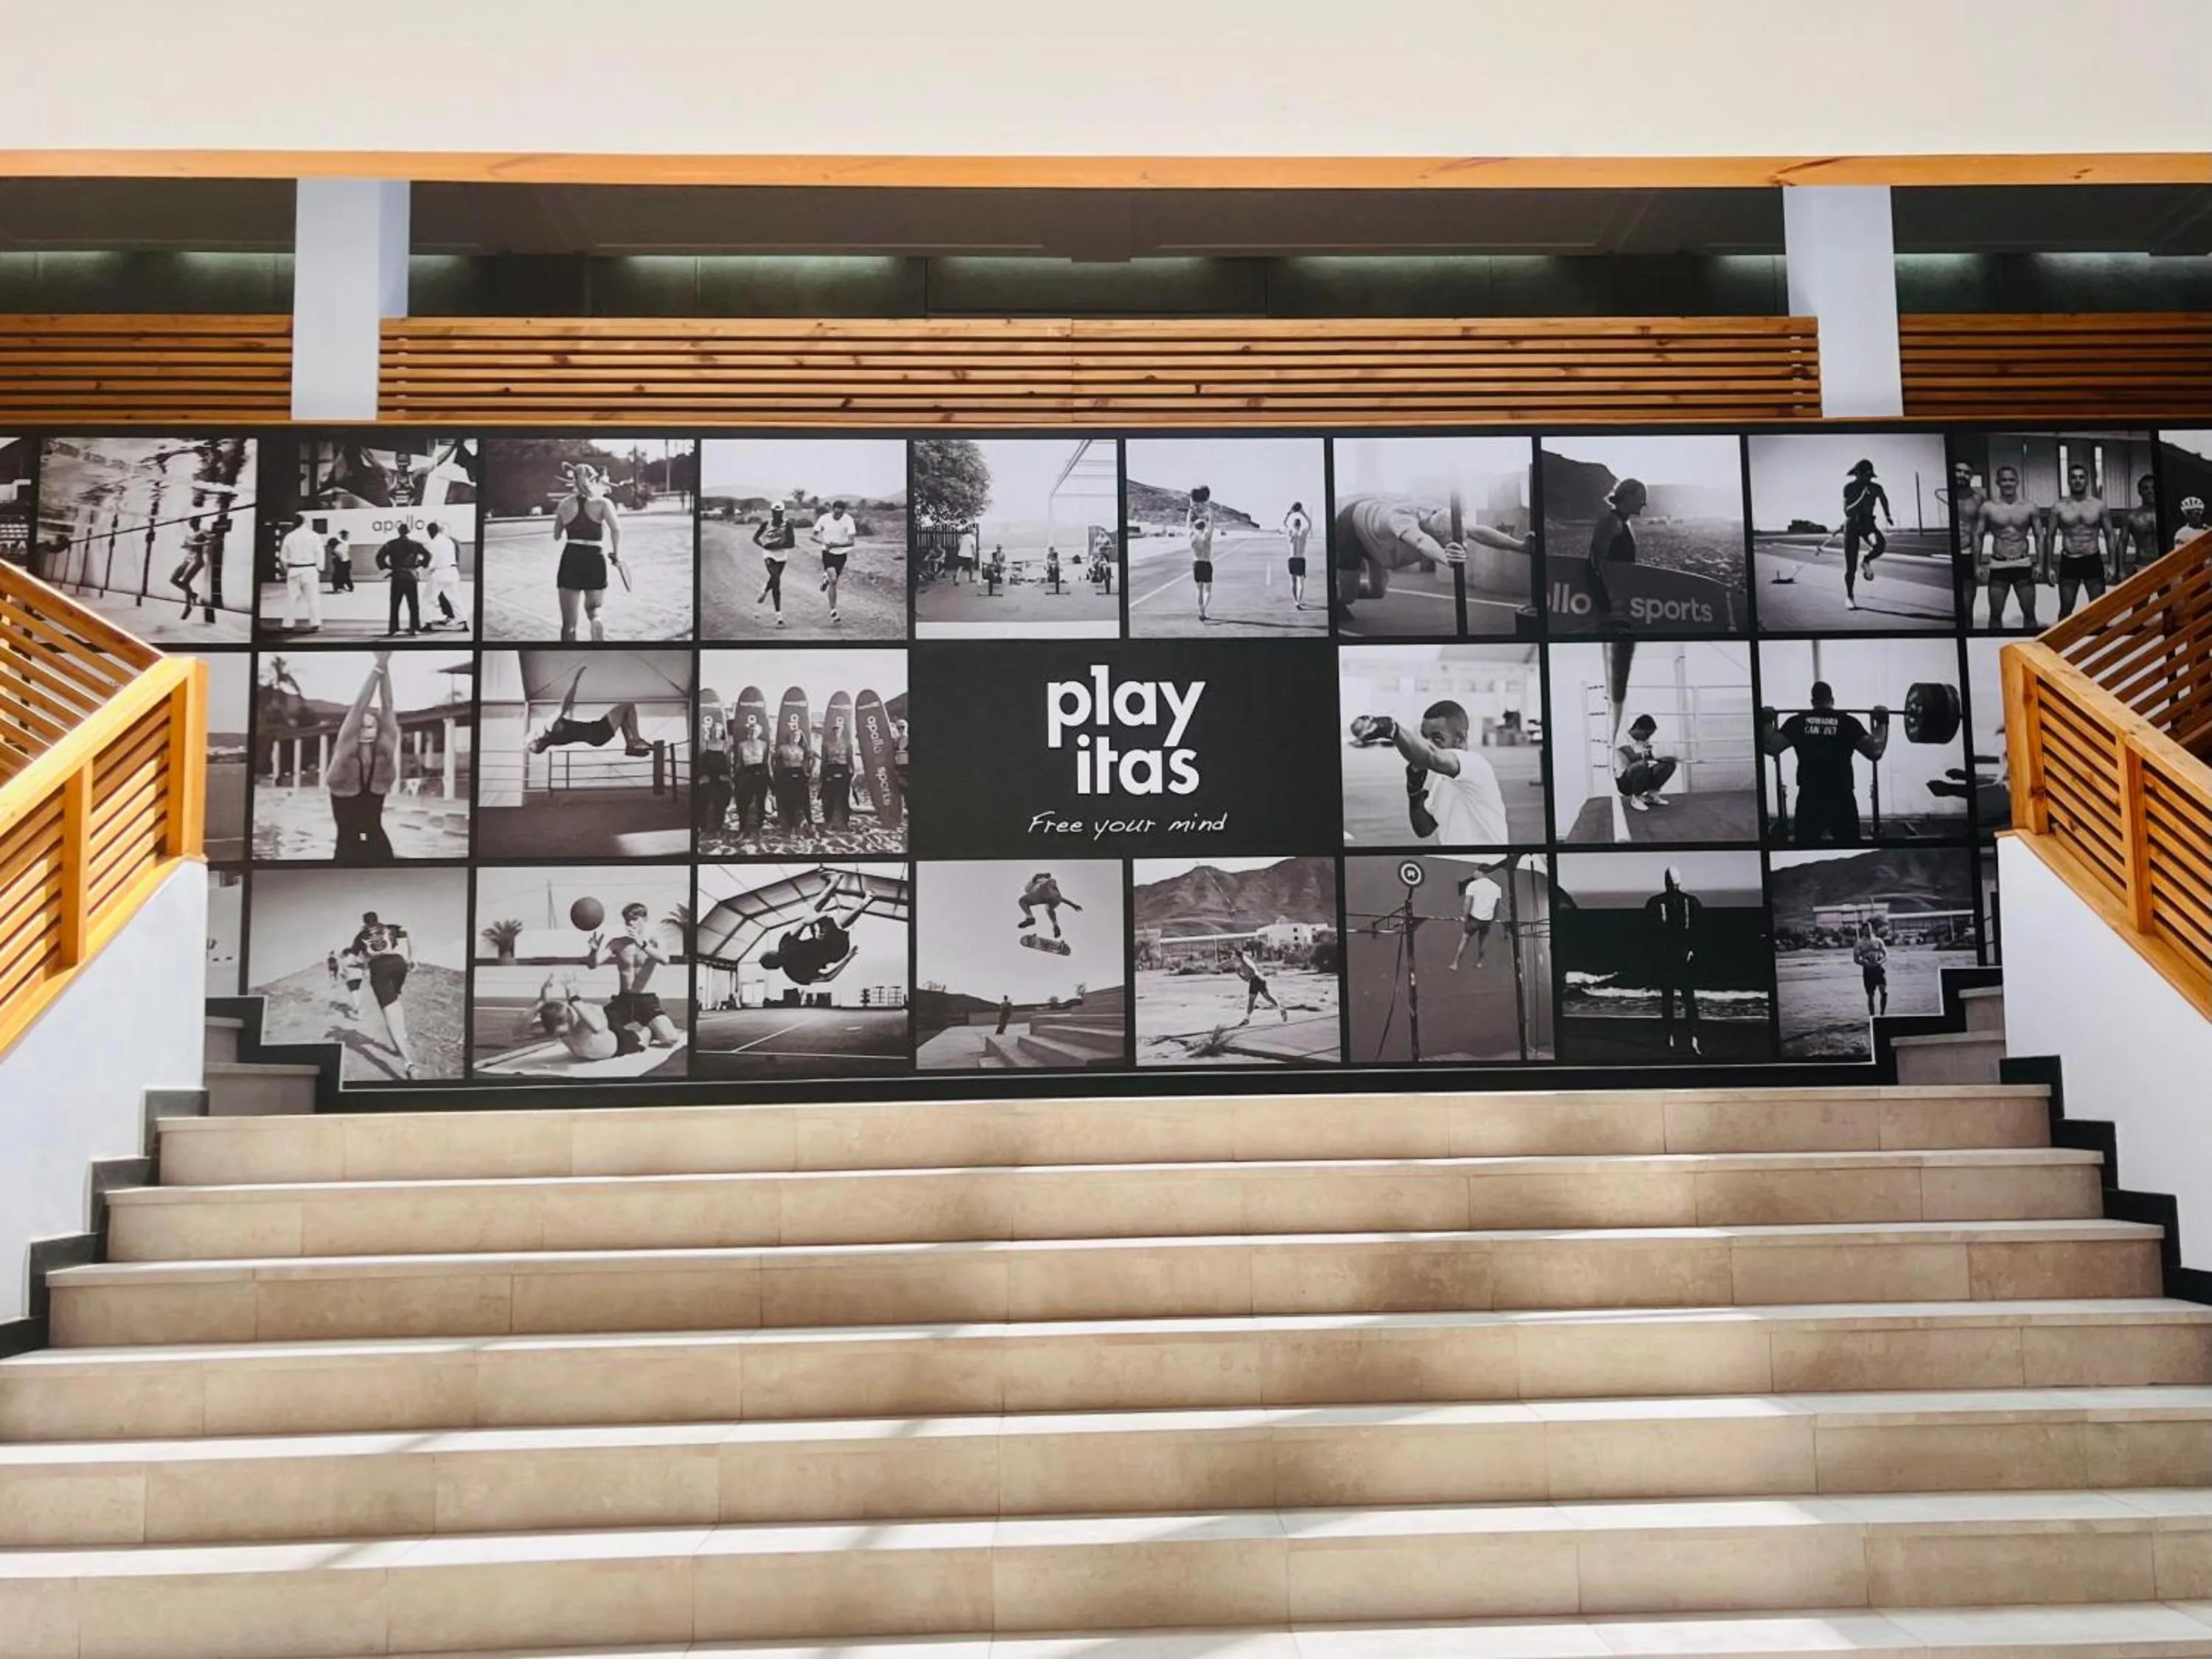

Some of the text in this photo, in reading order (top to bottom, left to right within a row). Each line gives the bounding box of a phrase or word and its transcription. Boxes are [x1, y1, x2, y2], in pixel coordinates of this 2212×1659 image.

[1546, 582, 1592, 615] llo
[1630, 597, 1714, 625] sports
[1047, 664, 1206, 748] play
[866, 714, 884, 754] apollo
[1077, 734, 1200, 795] itas
[1028, 810, 1228, 841] Free your mind
